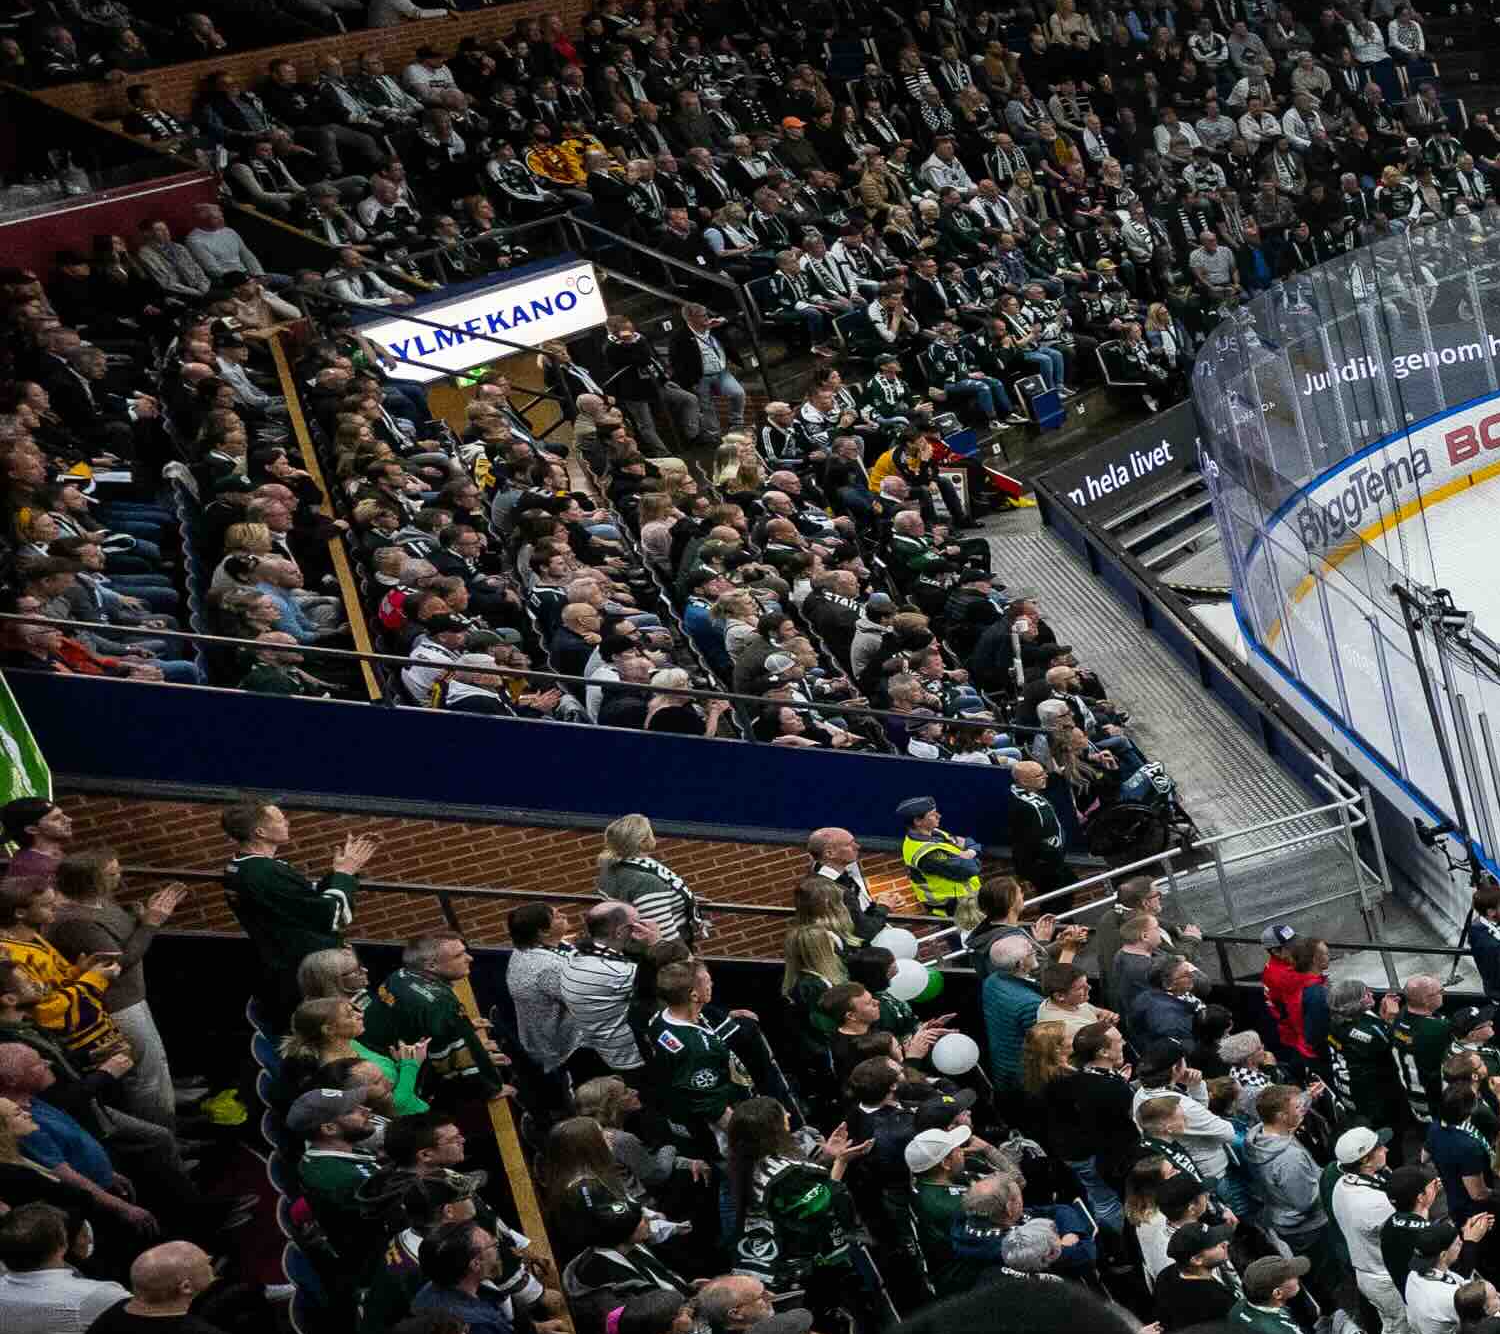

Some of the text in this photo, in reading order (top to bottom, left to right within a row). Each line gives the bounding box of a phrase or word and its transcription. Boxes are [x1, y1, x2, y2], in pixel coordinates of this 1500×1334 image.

[380, 289, 579, 365] YLMEKANO
[1392, 340, 1483, 381] genom
[1087, 438, 1175, 503] hela livet
